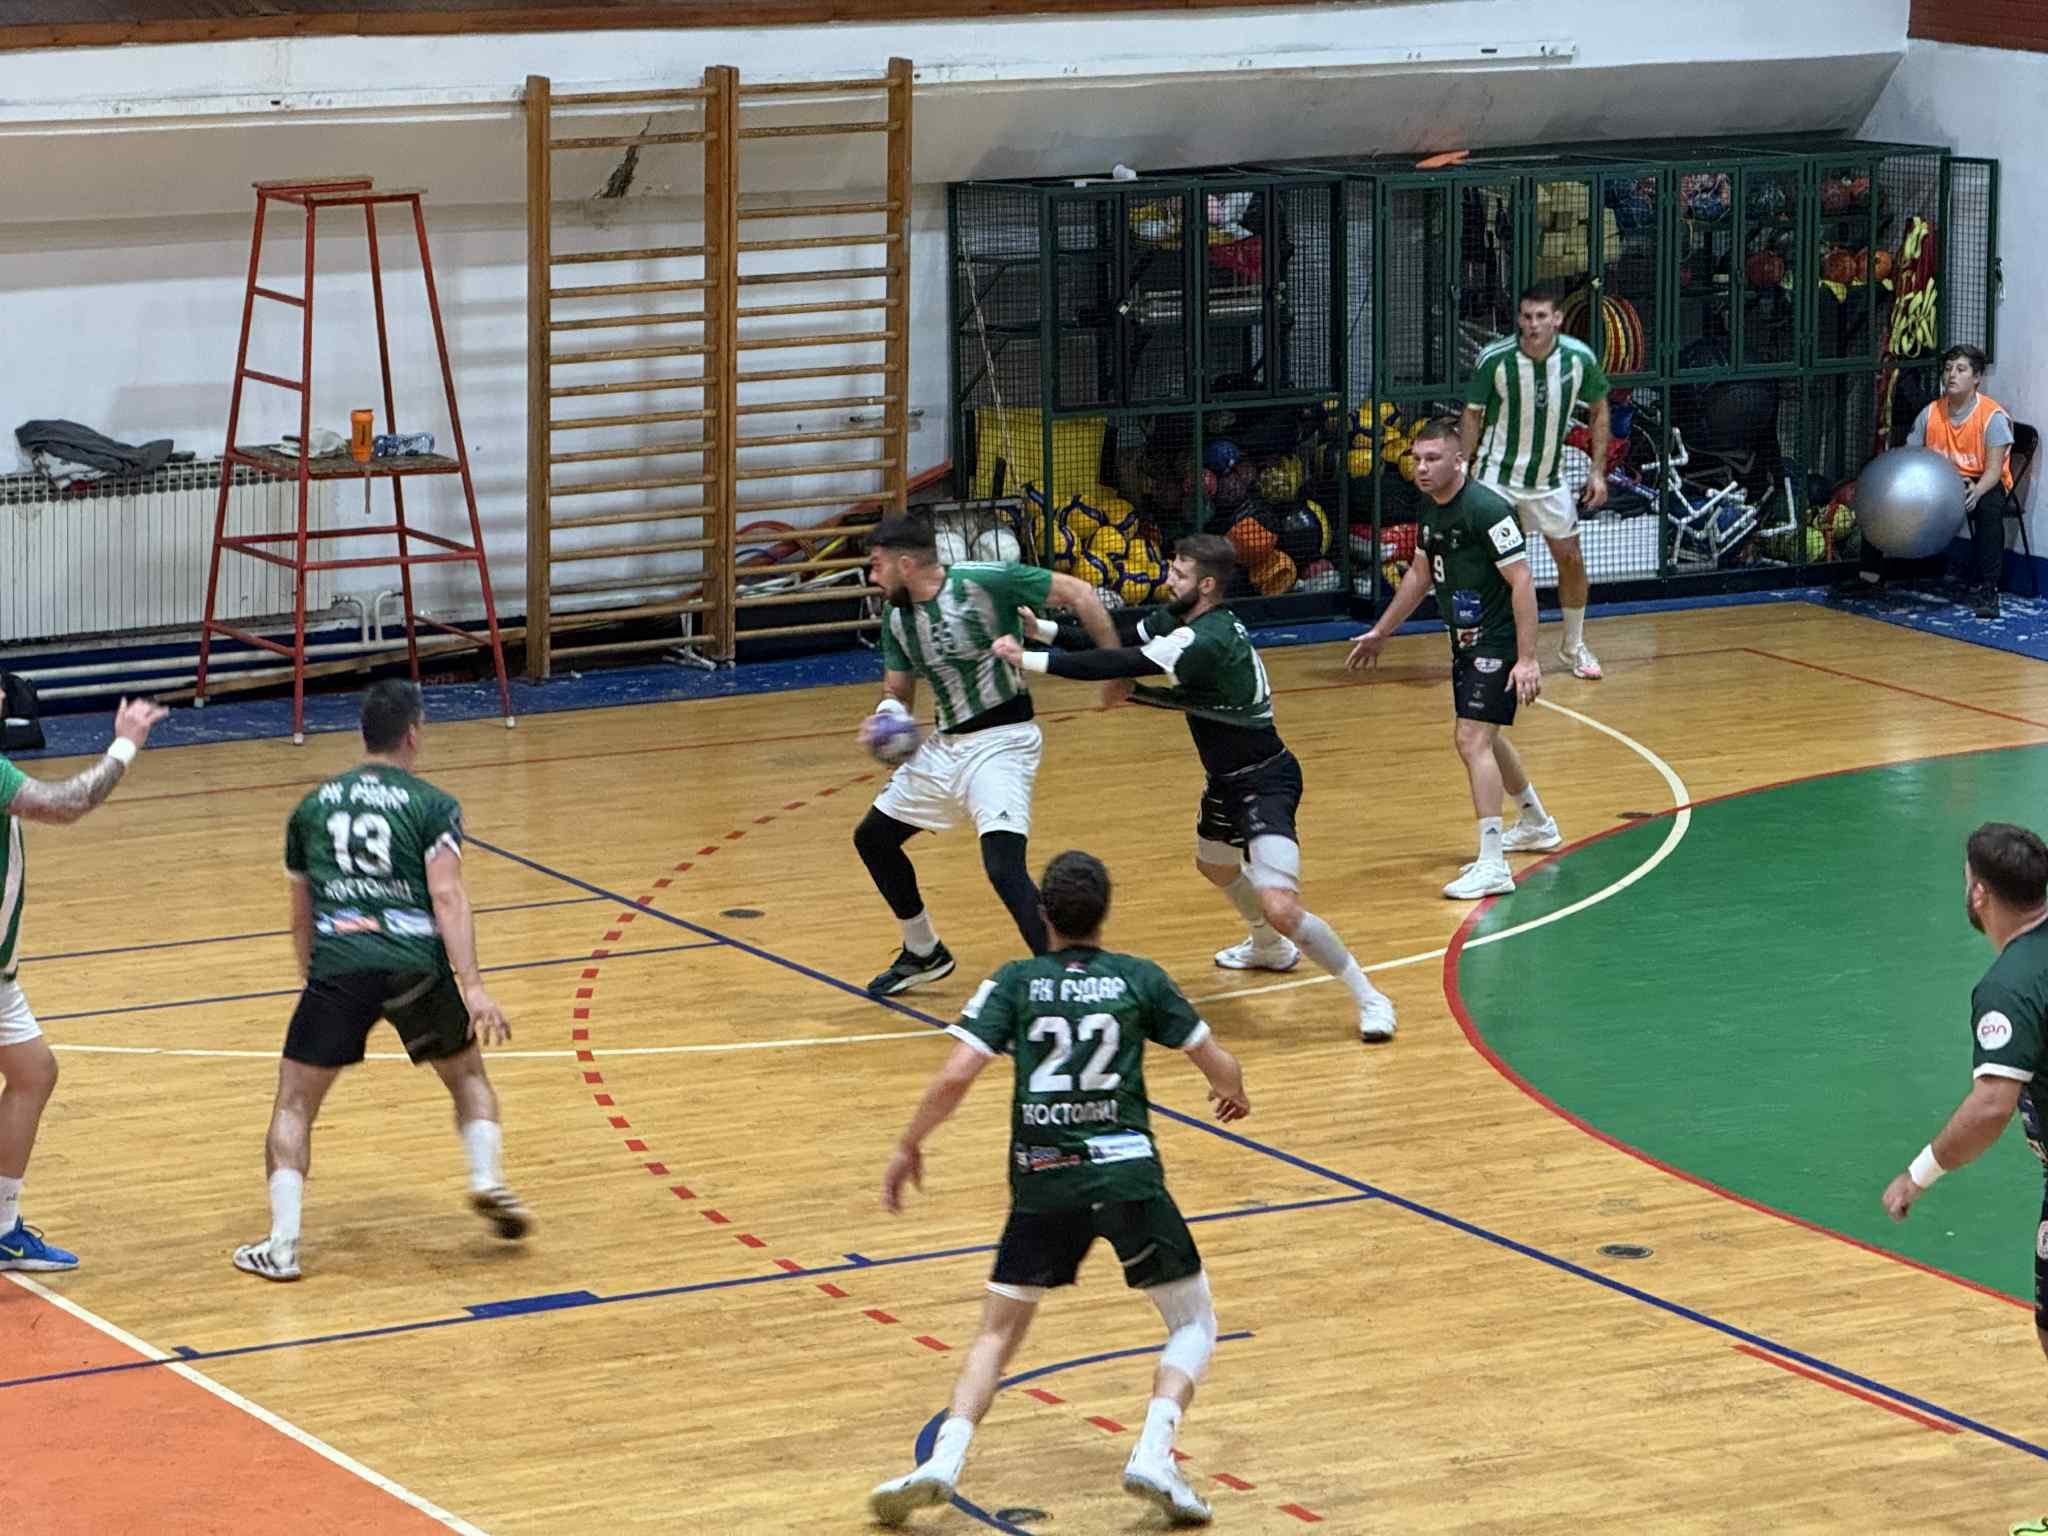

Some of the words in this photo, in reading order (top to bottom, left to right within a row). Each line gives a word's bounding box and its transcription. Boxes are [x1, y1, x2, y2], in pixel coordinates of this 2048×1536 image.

[1434, 555, 1445, 582] 9
[326, 811, 392, 876] 13
[1027, 1013, 1121, 1092] 22
